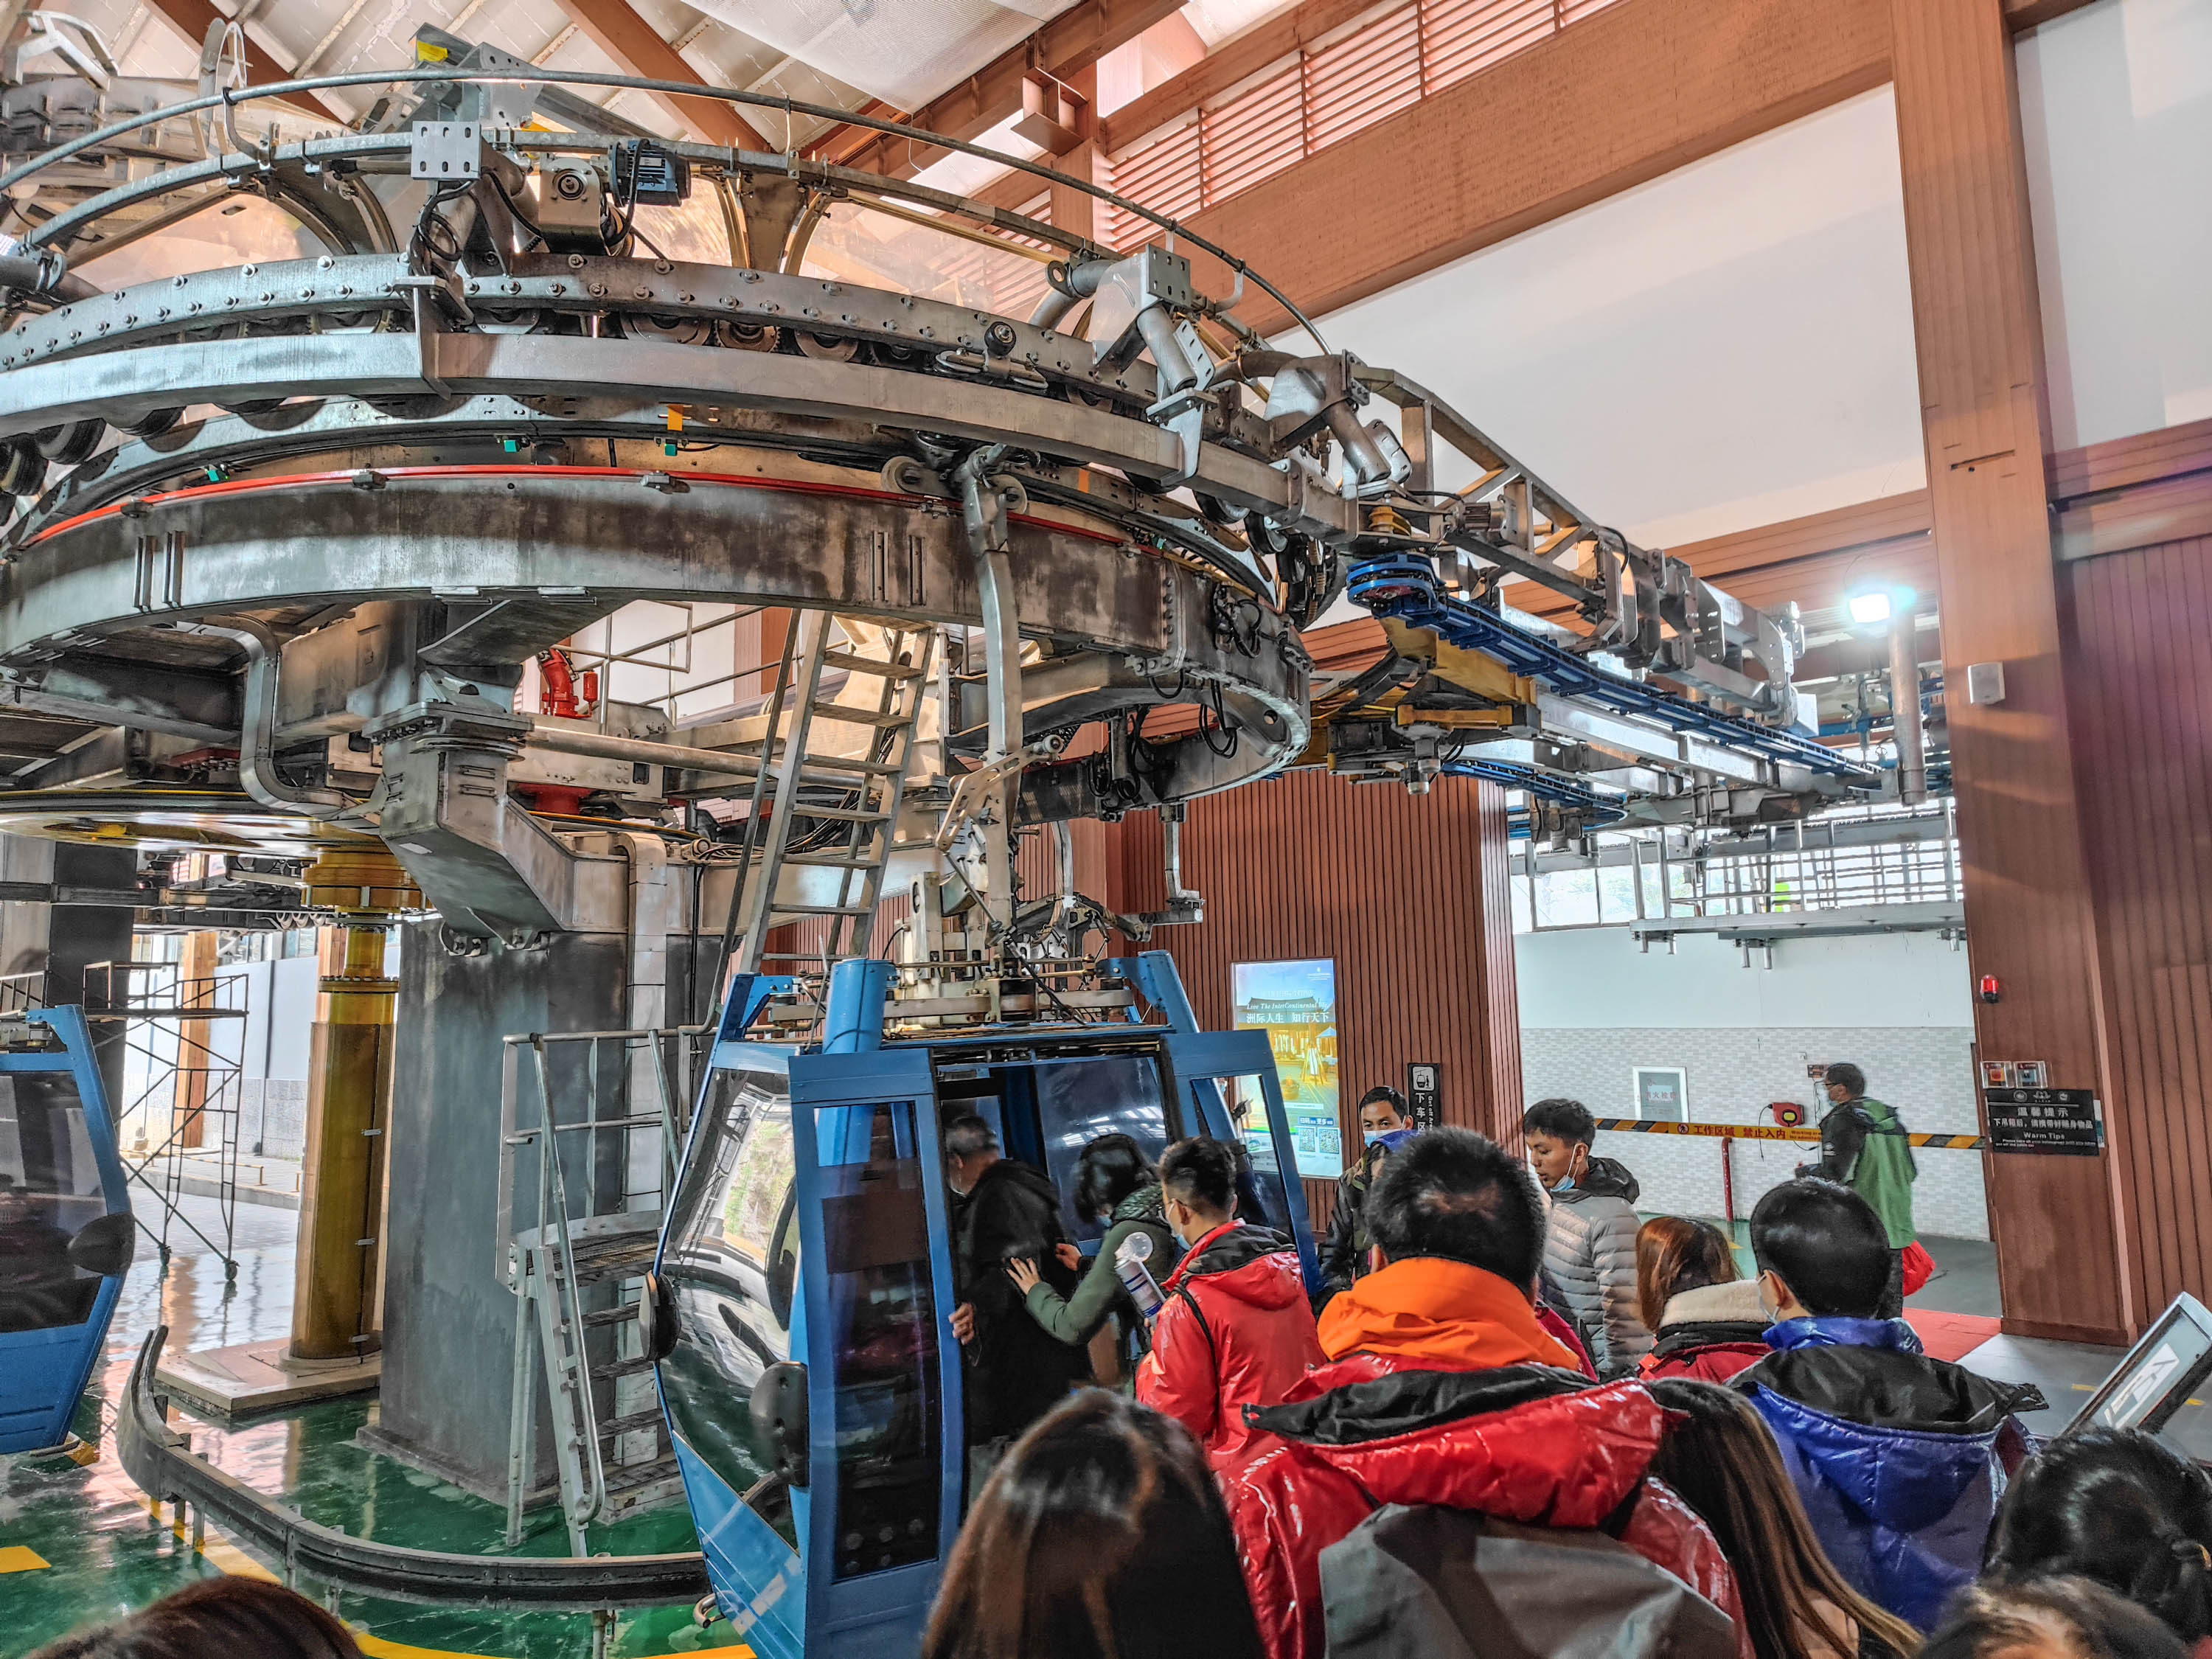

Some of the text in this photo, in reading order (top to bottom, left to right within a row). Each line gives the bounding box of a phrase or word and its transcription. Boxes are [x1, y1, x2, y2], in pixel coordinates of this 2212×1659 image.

[1246, 1012, 1329, 1023] 洲际人生 知行天下
[2017, 1107, 2068, 1117] 温馨提示
[1694, 1125, 1786, 1138] 工作区域 禁止入内
